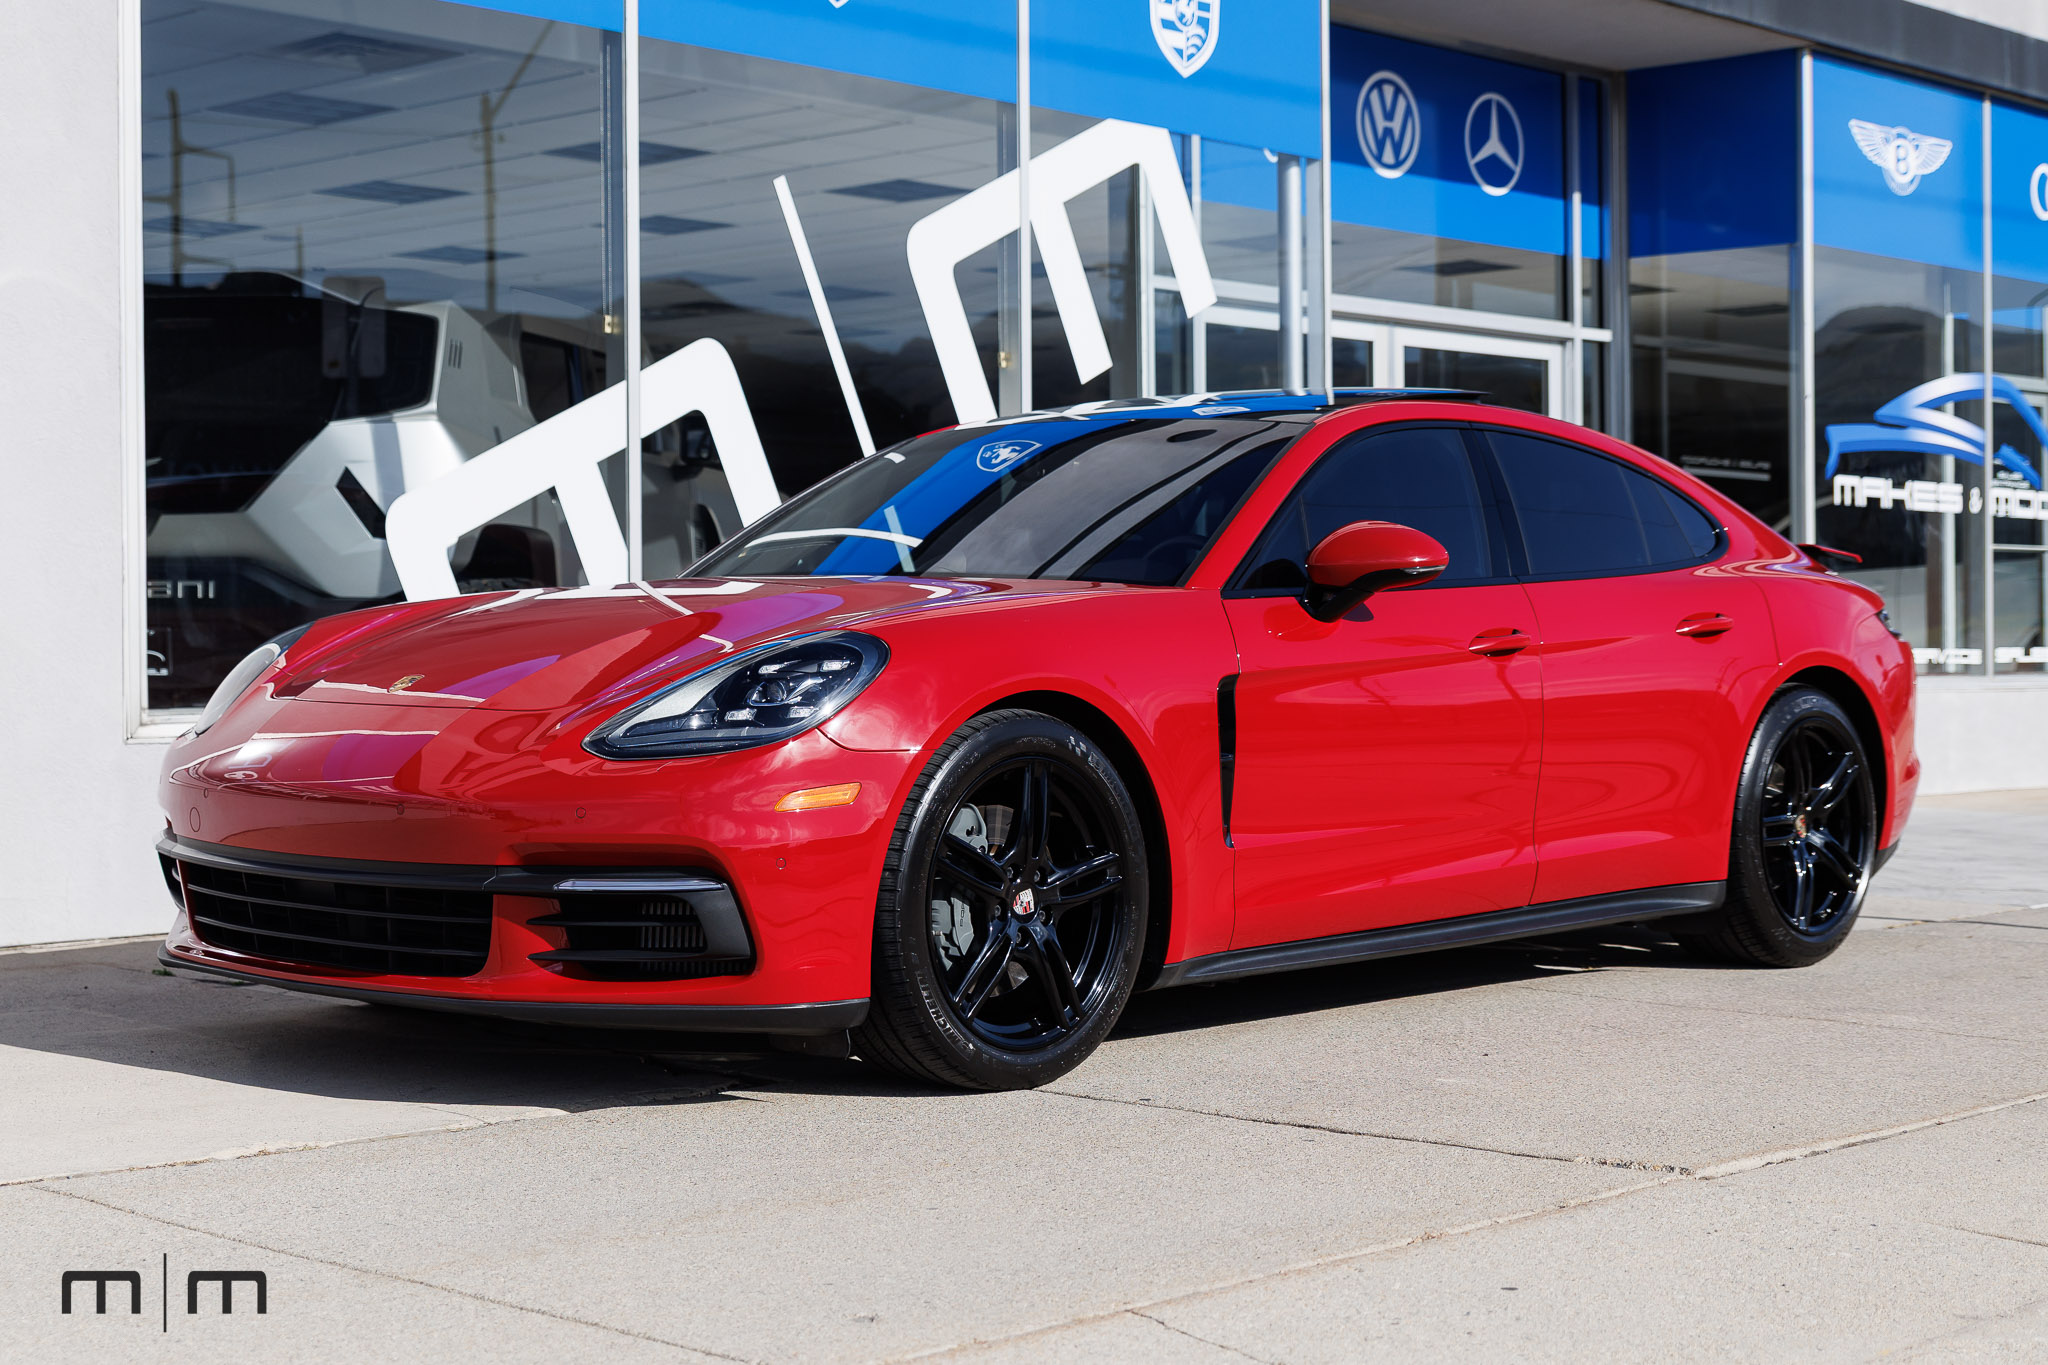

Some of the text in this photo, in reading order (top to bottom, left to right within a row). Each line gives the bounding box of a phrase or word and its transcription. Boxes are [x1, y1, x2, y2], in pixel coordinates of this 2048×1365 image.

[1834, 474, 1963, 514] MAKES
[1968, 486, 1983, 514] &
[1912, 647, 1982, 665] ERVICE
[916, 972, 962, 1048] MICHELIN
